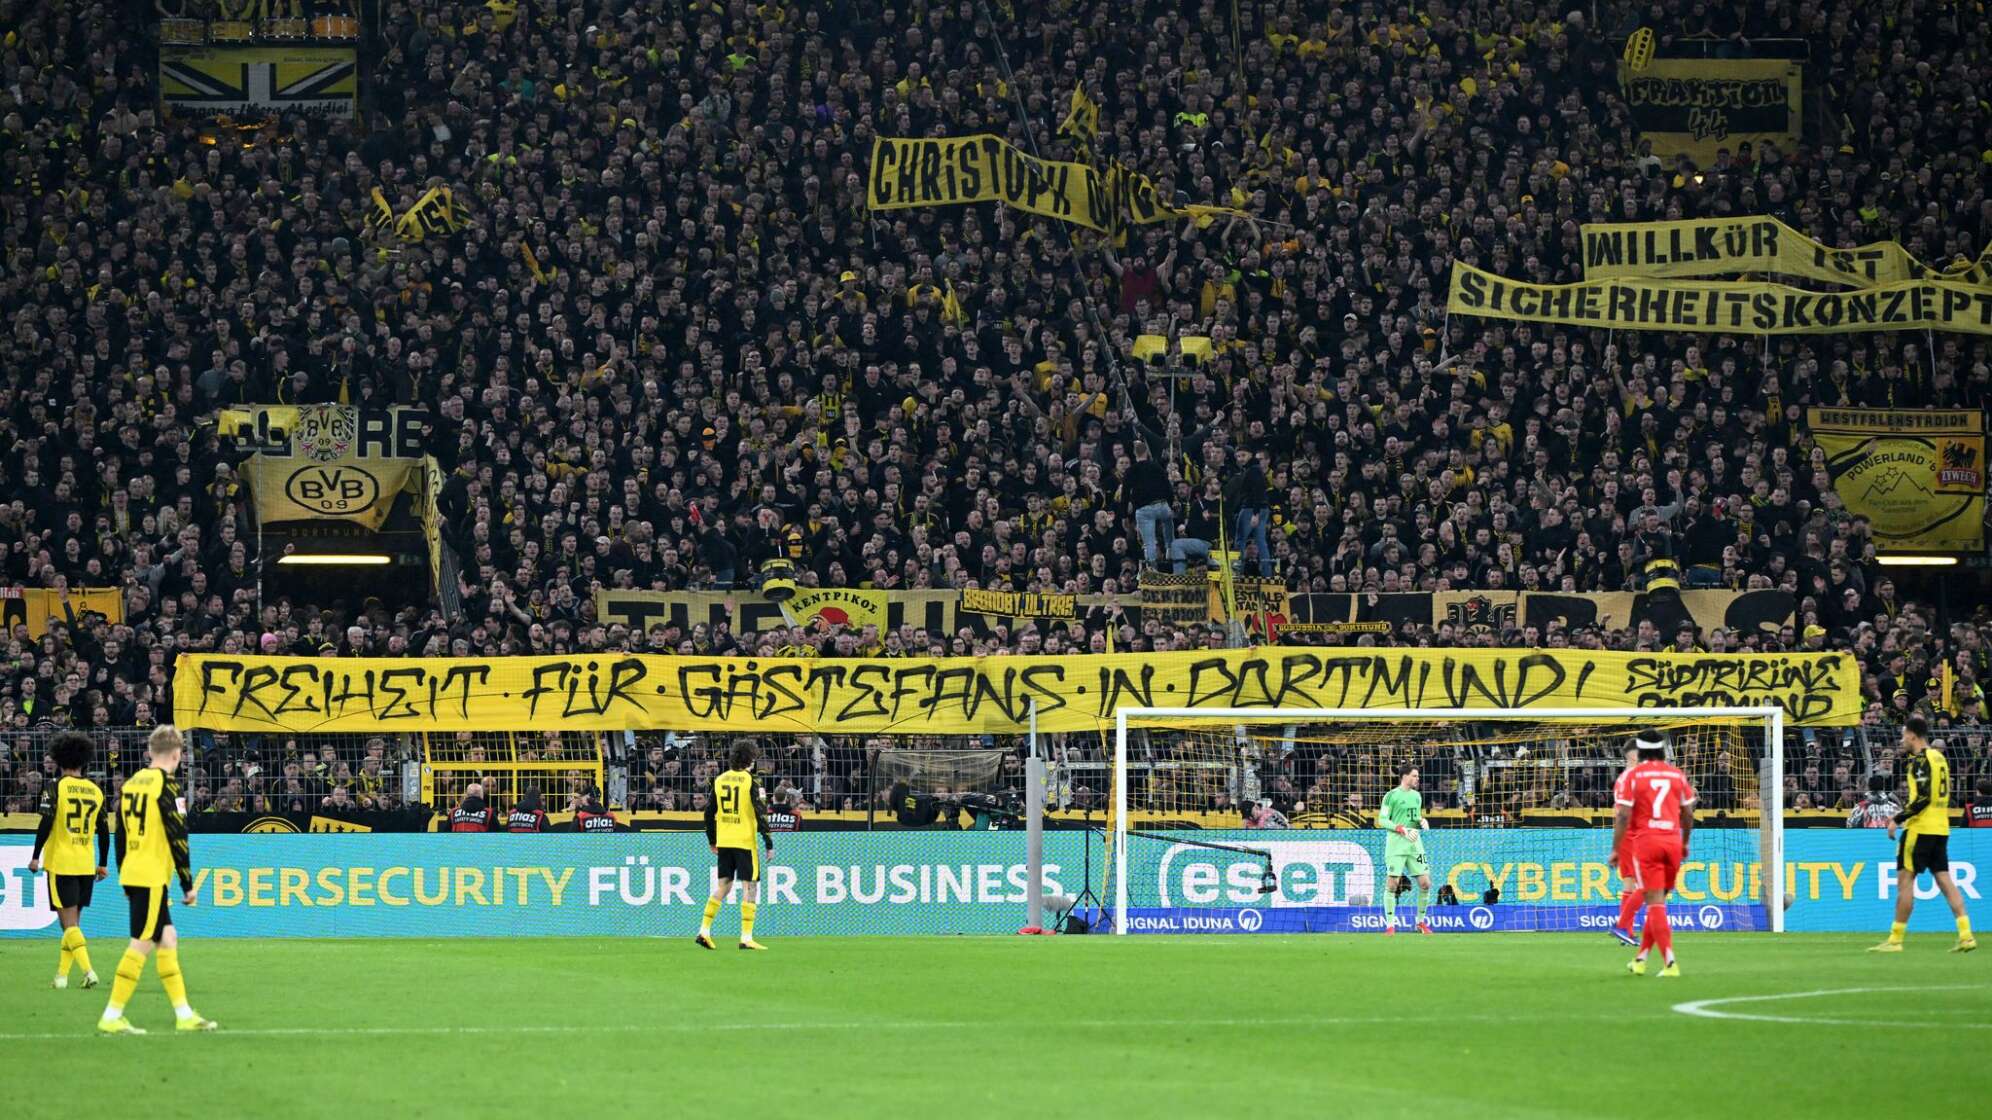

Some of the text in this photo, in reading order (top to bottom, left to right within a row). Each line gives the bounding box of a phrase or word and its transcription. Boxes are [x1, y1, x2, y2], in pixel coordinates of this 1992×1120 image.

[1688, 107, 1729, 142] 44
[1457, 271, 1992, 325] SICHERHEITSKONZEPT
[300, 469, 364, 499] BVB
[1847, 452, 1925, 480] POWERLAND
[320, 500, 348, 509] 09
[199, 660, 491, 722] FREIHEIT
[522, 658, 649, 721] FÜR
[678, 660, 1067, 724] GÄSTEFANS
[1099, 663, 1154, 718] IN
[66, 798, 98, 835] 27
[720, 785, 739, 814] 21
[1650, 779, 1671, 818] 7
[167, 867, 576, 907] BERSECURITY
[588, 855, 696, 905] FÜR
[1447, 862, 1865, 900] CYBERCUITY
[1183, 917, 1233, 929] IDUNA
